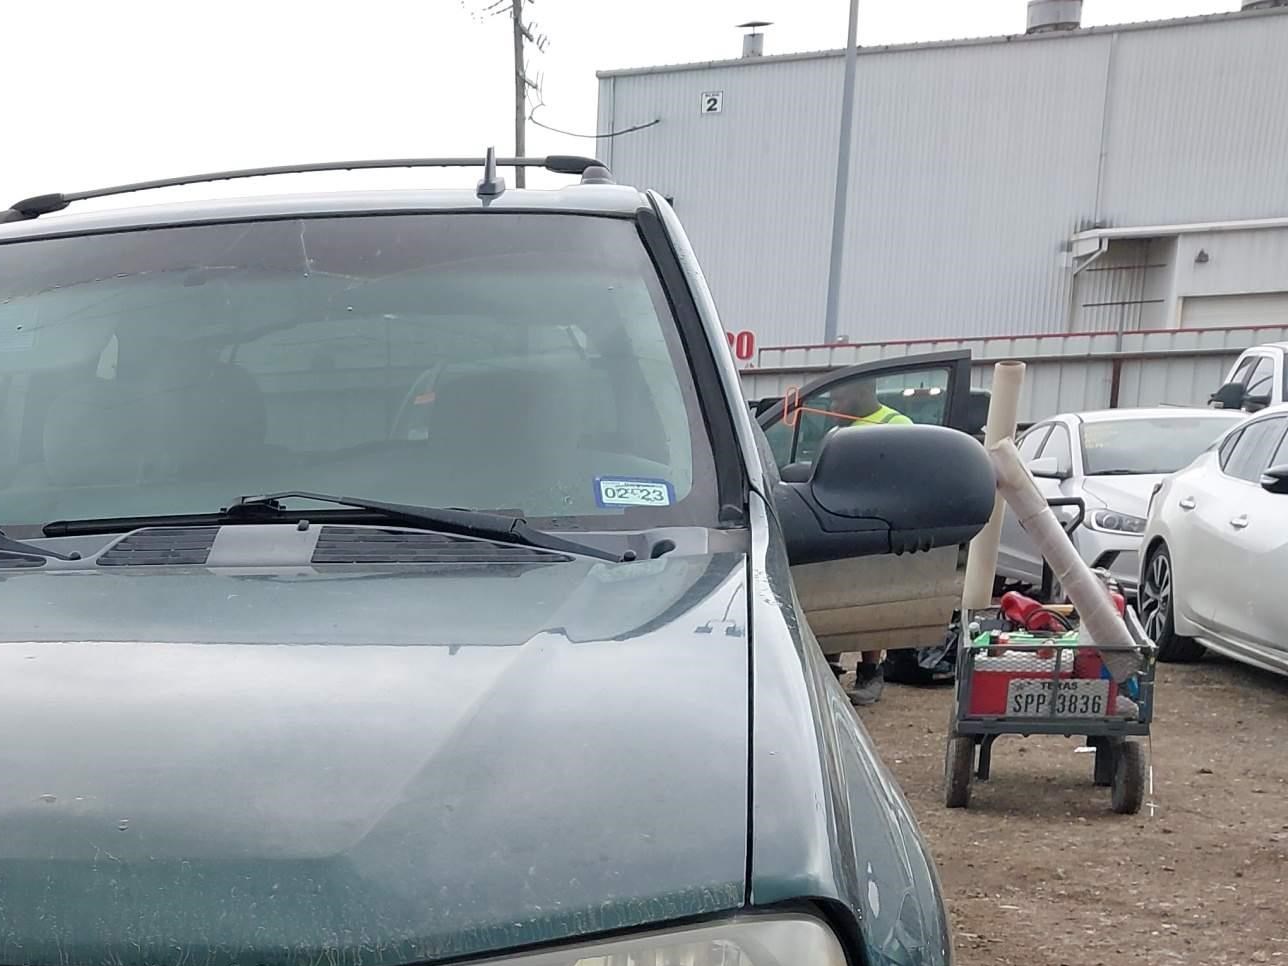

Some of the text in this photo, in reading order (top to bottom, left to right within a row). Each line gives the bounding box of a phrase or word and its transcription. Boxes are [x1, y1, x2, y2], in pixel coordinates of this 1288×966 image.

[706, 98, 718, 112] 2
[1012, 694, 1102, 714] SPP 3836
